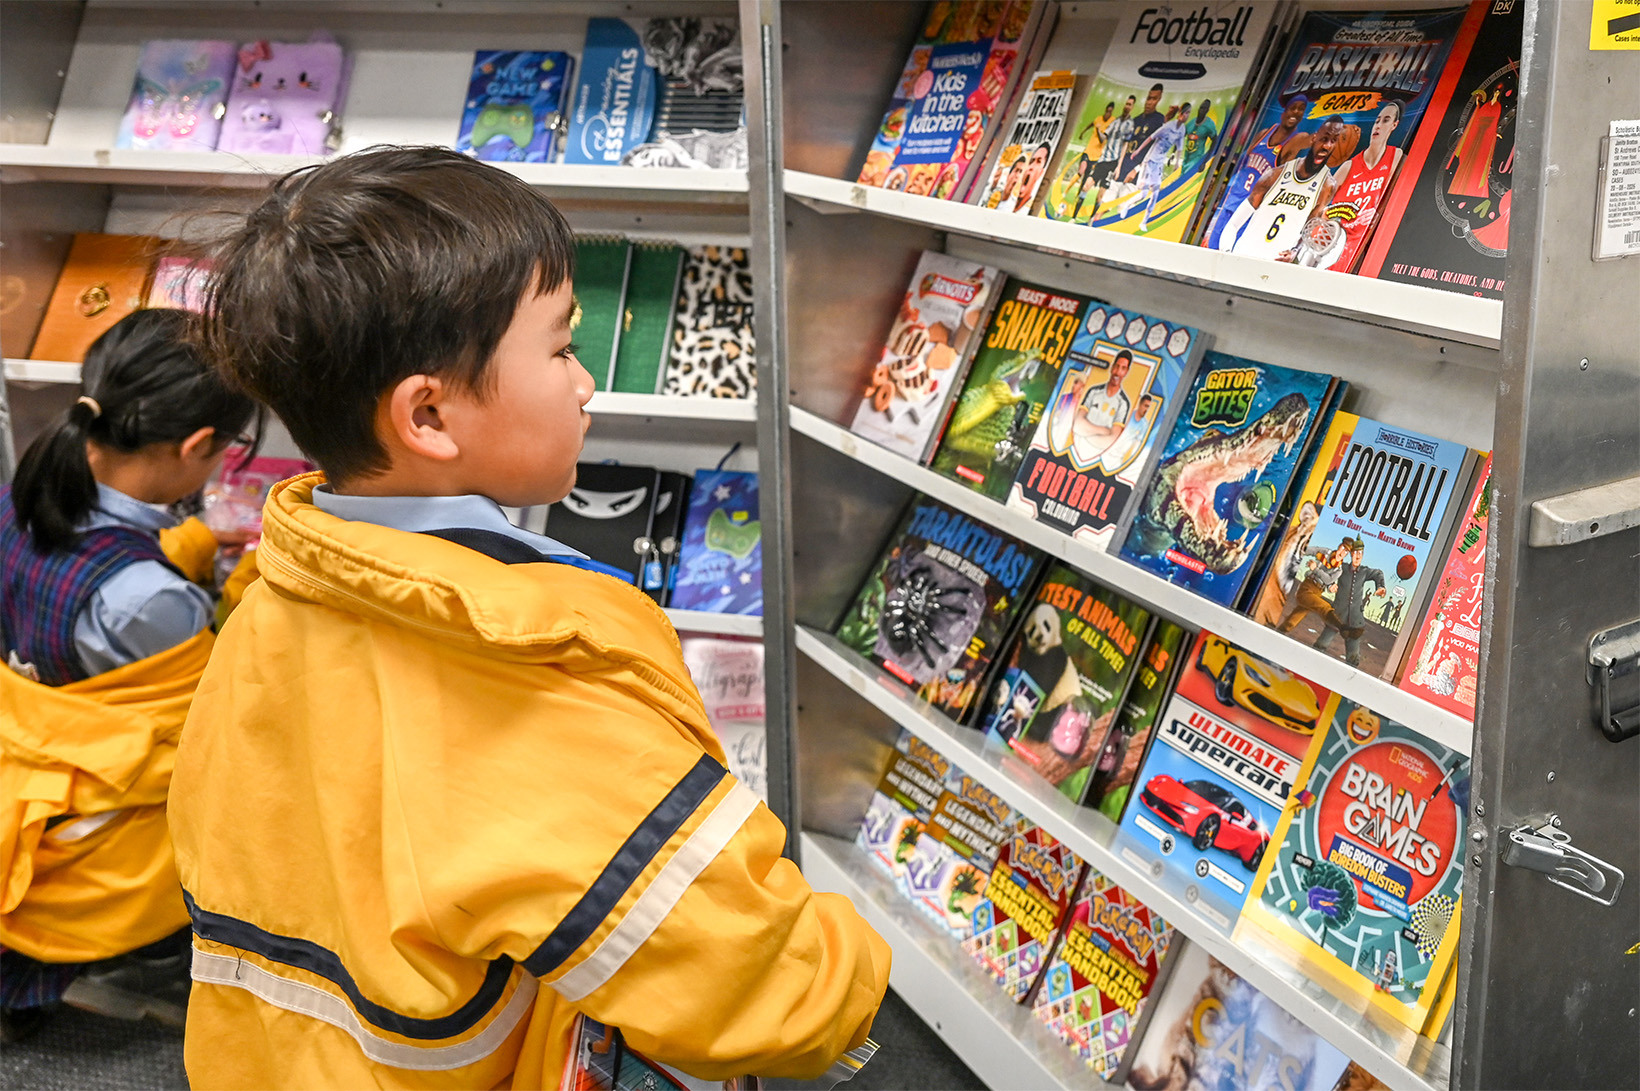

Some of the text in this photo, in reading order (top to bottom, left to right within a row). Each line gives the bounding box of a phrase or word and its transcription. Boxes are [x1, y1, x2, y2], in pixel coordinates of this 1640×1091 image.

[1495, 1, 1510, 10] DK
[1129, 7, 1253, 46] Football
[1335, 29, 1423, 44] Greatest of All Time
[1185, 46, 1240, 60] Encyclopedia
[1283, 43, 1437, 94] BASKETBALL
[486, 81, 540, 97] GAME
[494, 66, 540, 82] NEW
[933, 70, 968, 94] Kids
[603, 48, 639, 161] ESSENTIALS
[922, 92, 965, 113] in the
[1029, 93, 1062, 120] REAL
[1322, 92, 1371, 111] GOATS
[1010, 119, 1060, 146] MADRID
[1268, 189, 1310, 210] LAKERS
[1347, 177, 1383, 196] FEVER
[1265, 214, 1286, 243] 6
[1391, 263, 1409, 275] MEET
[1408, 265, 1421, 277] THE
[1480, 277, 1495, 290] AND
[1017, 288, 1078, 313] BEAST MODE
[987, 300, 1079, 369] SNAKES!
[1206, 369, 1256, 389] GATOR
[1194, 387, 1255, 422] BITES
[1027, 457, 1116, 521] FOOTBALL
[1328, 443, 1449, 542] FOOTBALL
[907, 505, 1033, 597] TARANTULAS!
[1171, 553, 1206, 573] SCHOLASTIC
[1038, 582, 1137, 656] TEST ANIMALS
[1067, 617, 1125, 674] OF ALL TIME!
[1149, 643, 1169, 673] LS
[1189, 712, 1290, 776] ULTIMATE
[934, 812, 953, 829] AND
[944, 798, 1006, 844] LEGENDARY
[1343, 802, 1440, 877] GAMES
[1329, 849, 1406, 899] BOREDOM BUSTERS
[1339, 841, 1388, 875] BIG BOOK OF
[985, 882, 1050, 946] HANDBOOK
[991, 868, 1055, 935] ESSENTIAL
[1061, 943, 1138, 1016] HANDBOOK
[1067, 926, 1144, 1000] ESSENTIAL
[1192, 997, 1302, 1091] CATS
